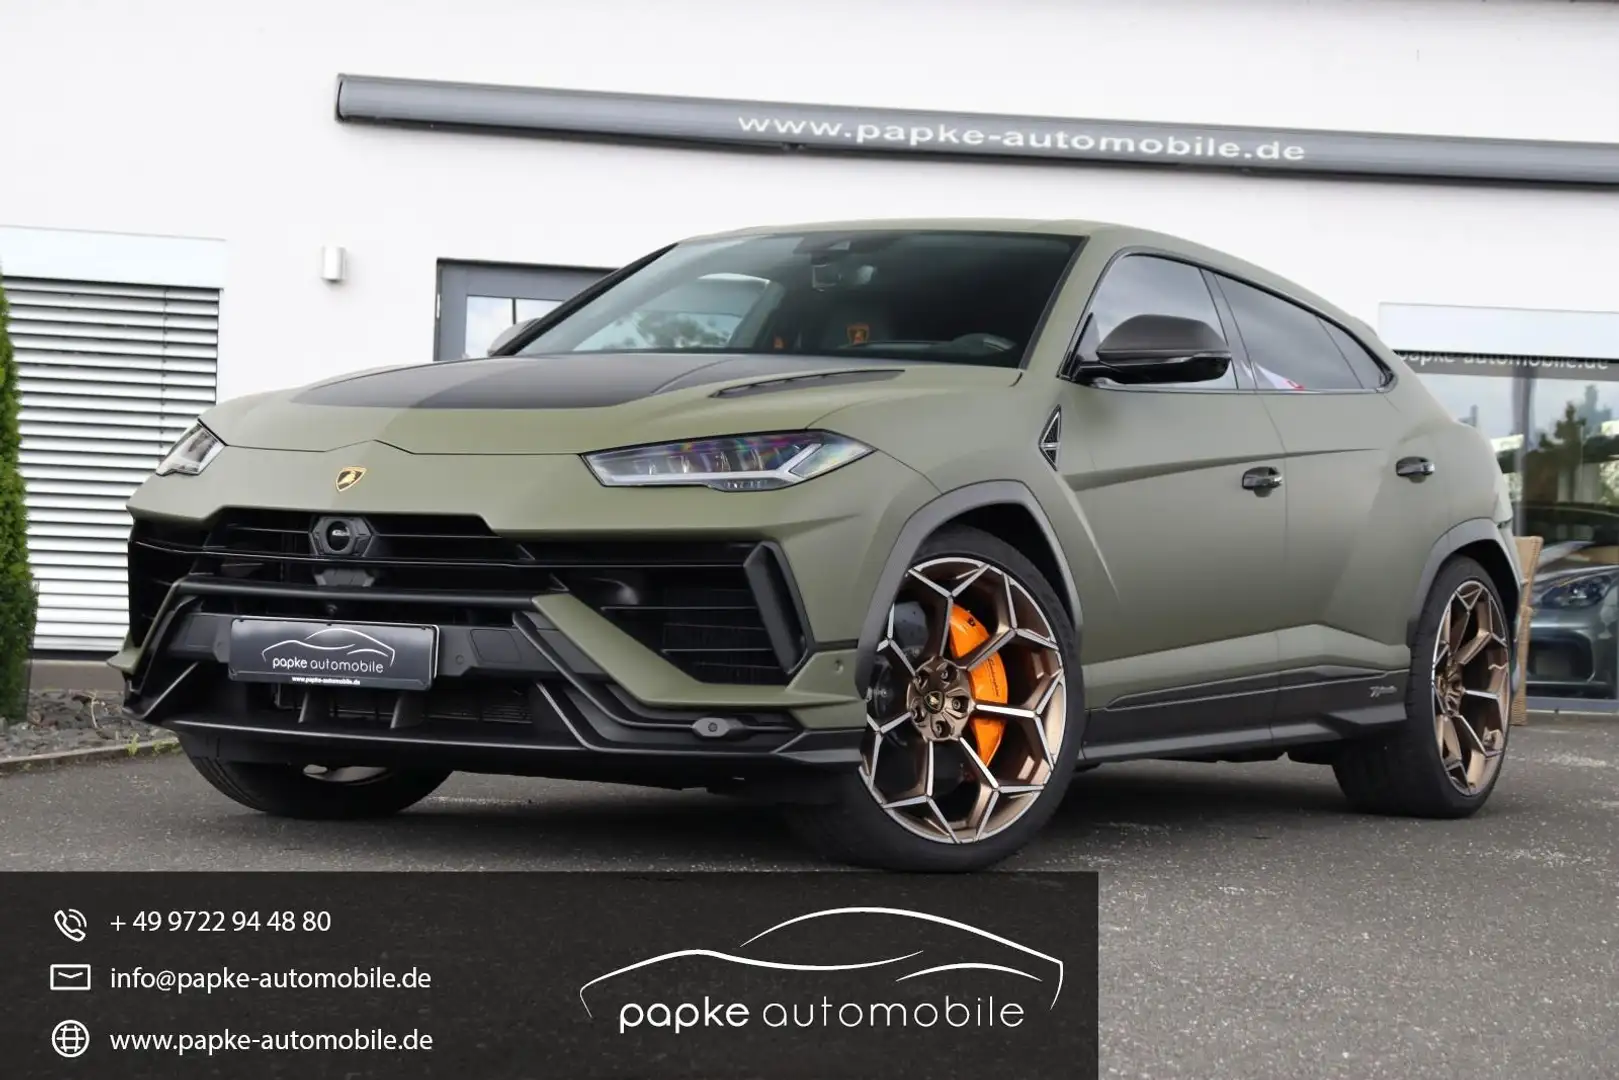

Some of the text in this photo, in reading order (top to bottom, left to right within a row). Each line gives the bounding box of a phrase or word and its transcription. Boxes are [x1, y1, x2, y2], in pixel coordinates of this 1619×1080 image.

[738, 115, 1306, 161] www.papke-automobile.de
[272, 656, 384, 674] papke automobile
[291, 676, 361, 686] www.papke-automobile.de
